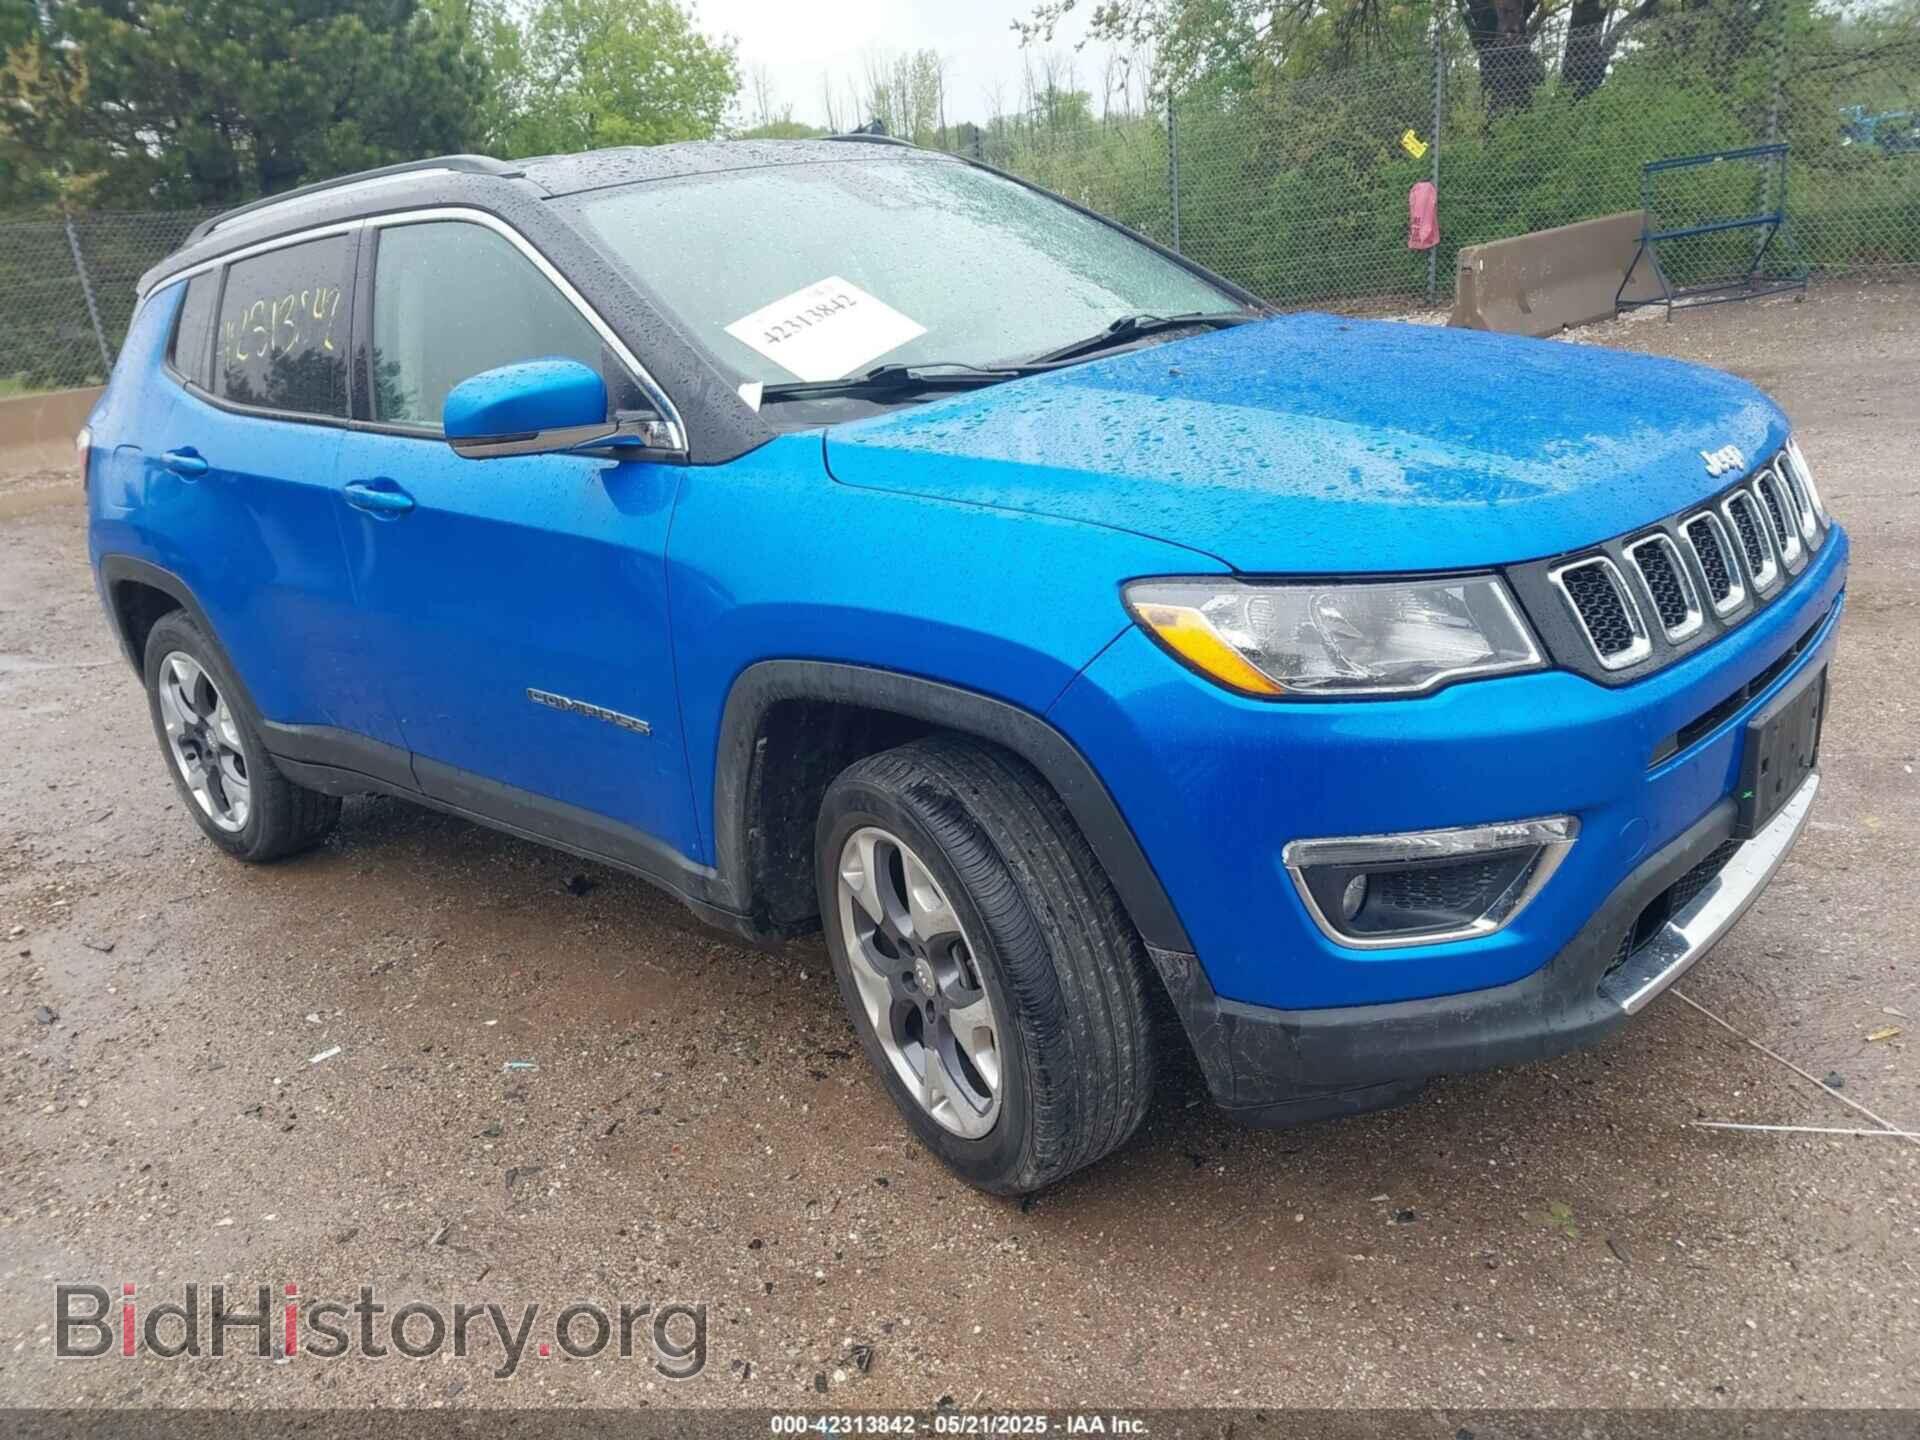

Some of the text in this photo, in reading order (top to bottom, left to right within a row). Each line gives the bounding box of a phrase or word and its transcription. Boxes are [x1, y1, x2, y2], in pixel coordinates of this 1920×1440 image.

[763, 293, 858, 345] 42313842
[1699, 444, 1745, 476] Jeep
[526, 687, 650, 736] COMPASS
